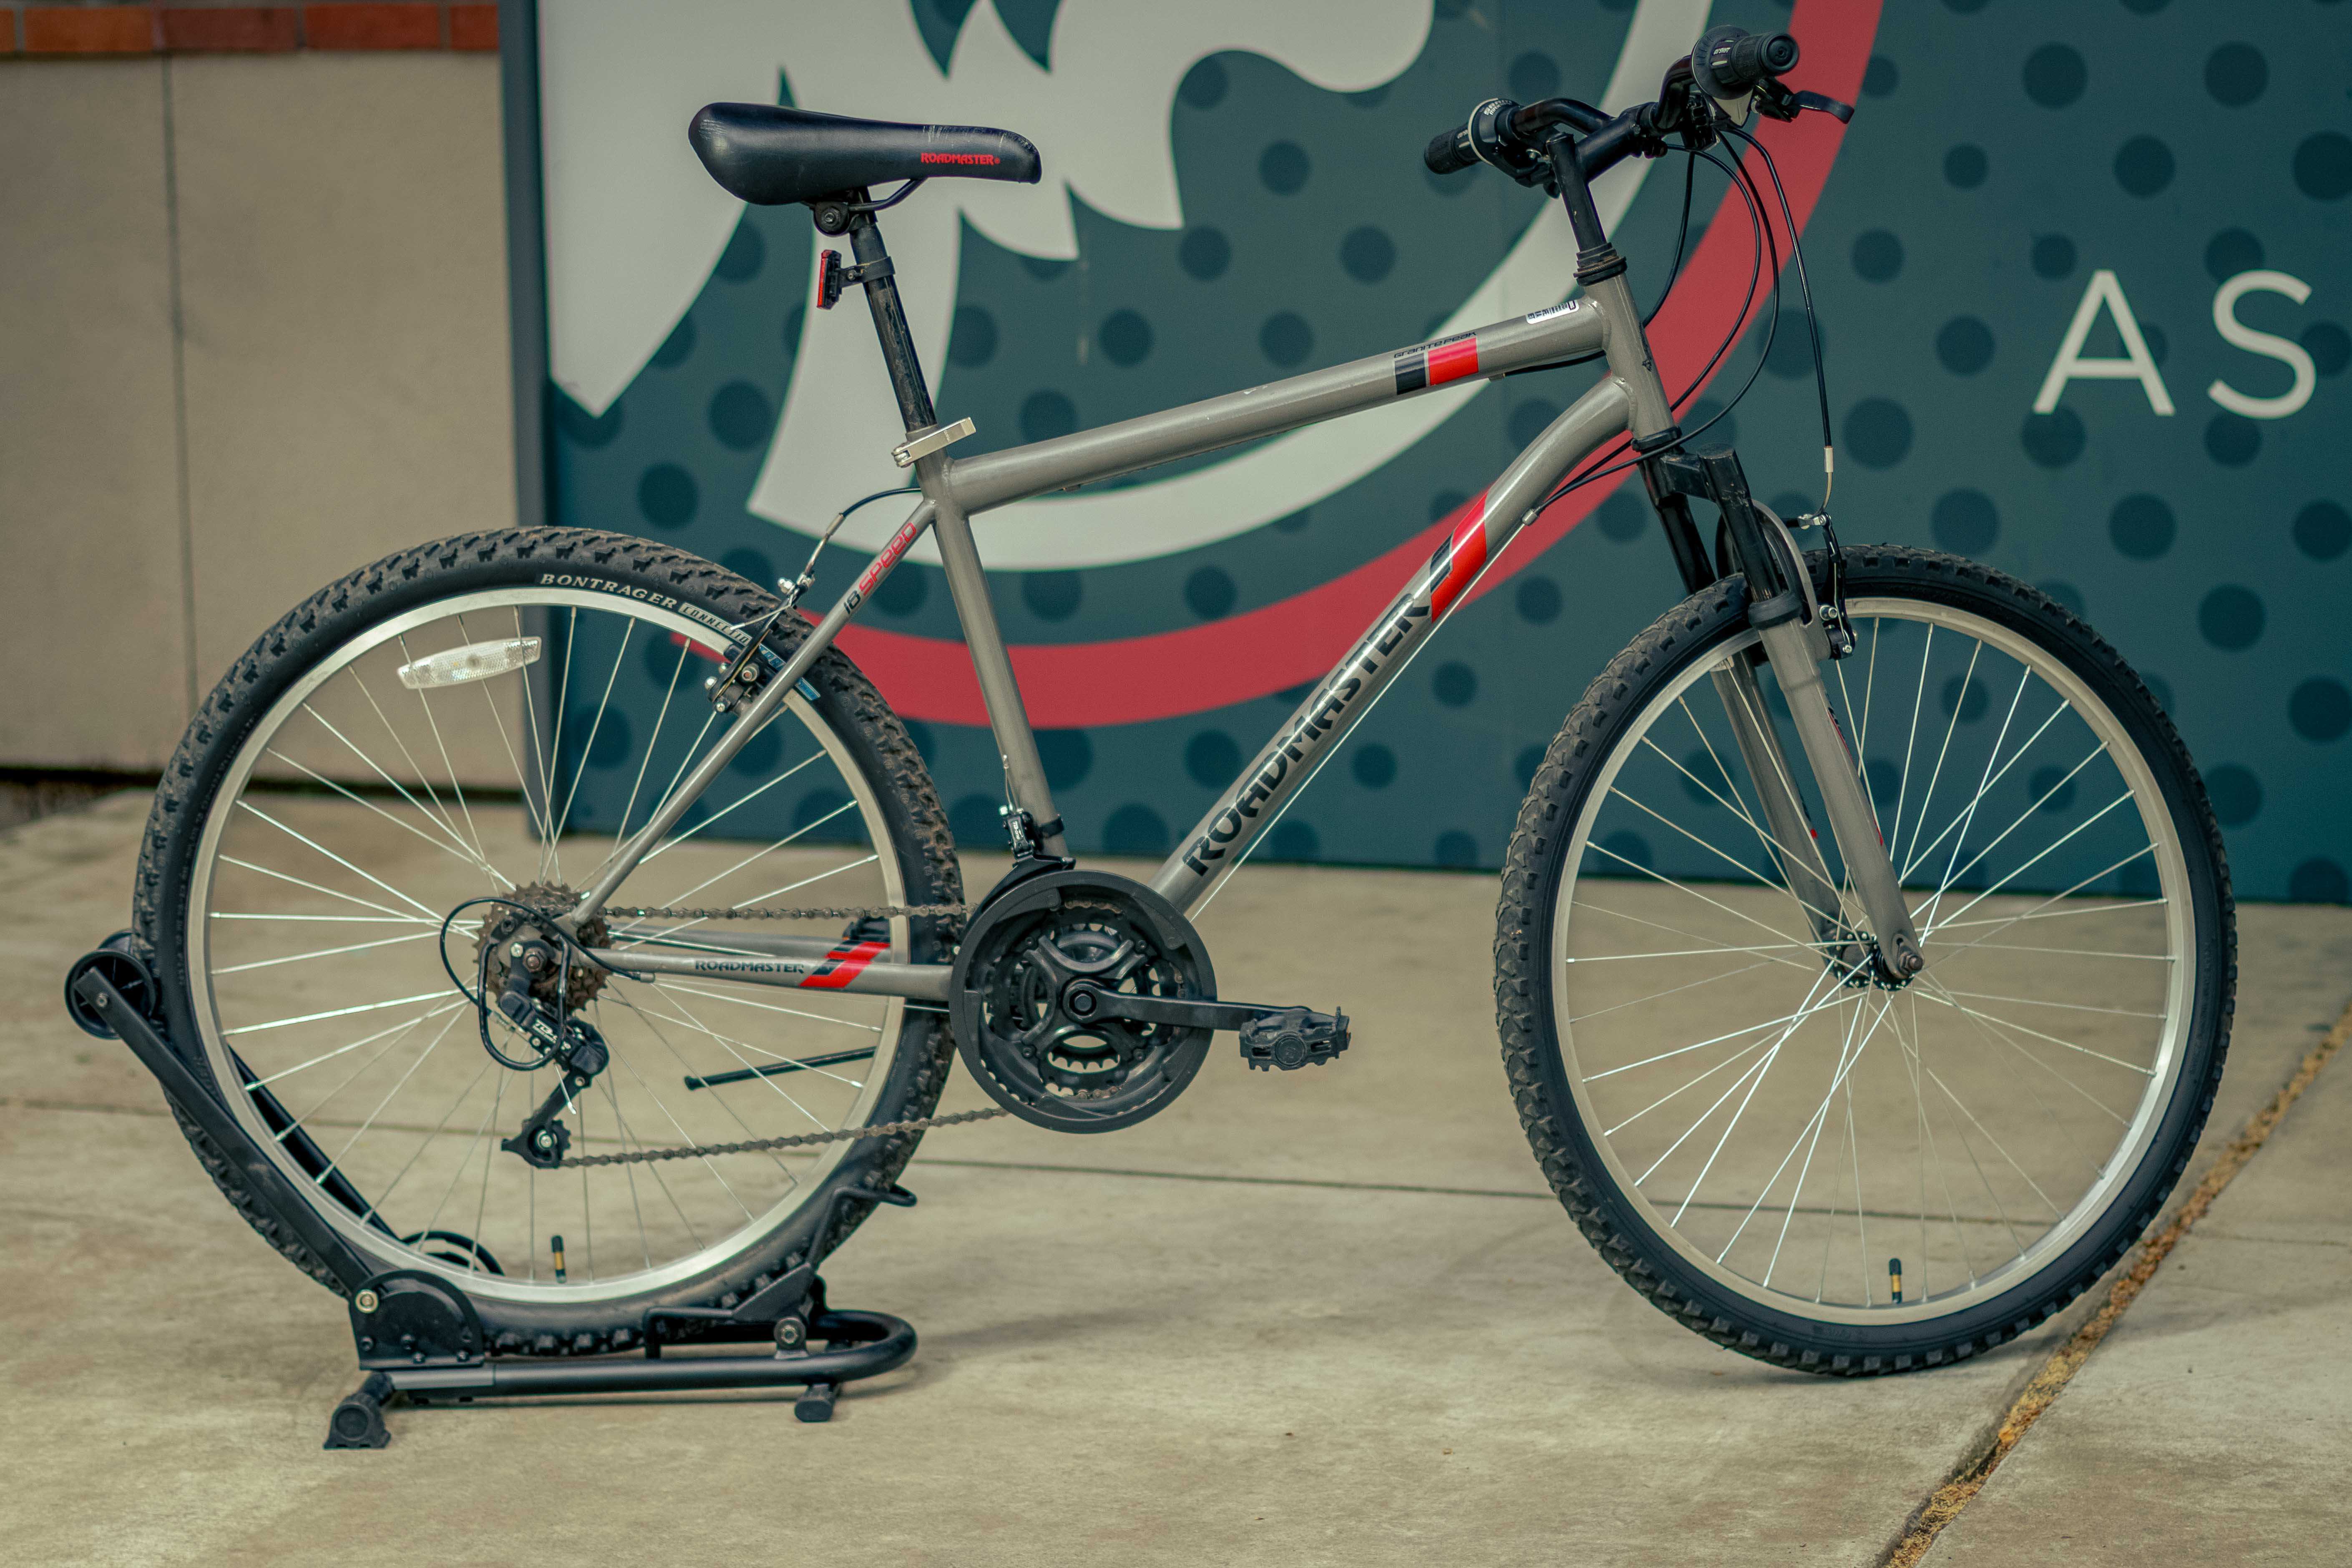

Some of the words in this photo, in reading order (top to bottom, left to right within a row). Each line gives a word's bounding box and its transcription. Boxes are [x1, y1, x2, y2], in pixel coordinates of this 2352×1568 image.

[921, 152, 995, 166] ROADMASTER
[2032, 268, 2317, 420] AS
[541, 573, 677, 609] BONTRAGER
[682, 606, 750, 645] CONNECTIO
[843, 590, 861, 614] 18
[1182, 593, 1430, 876] ROADMASTER
[695, 960, 805, 974] ROADMASTER
